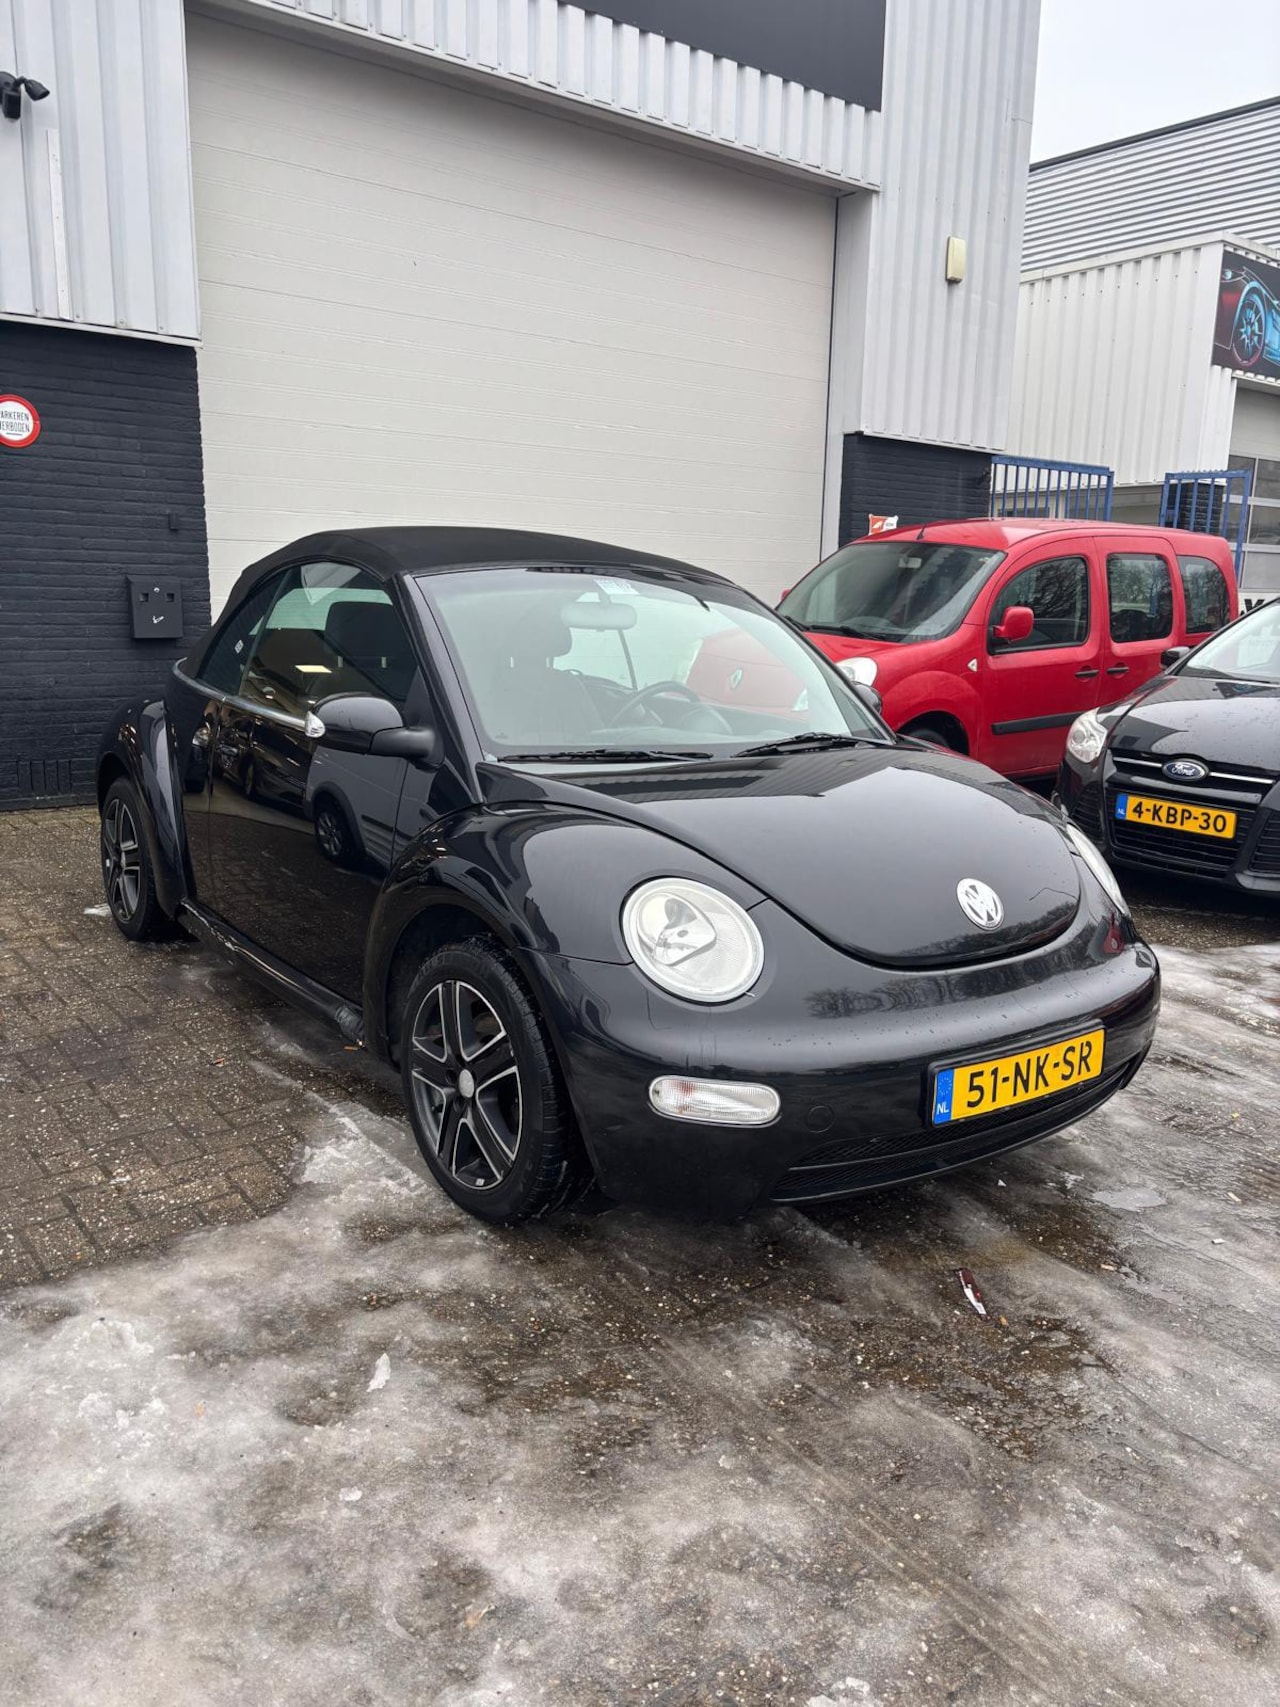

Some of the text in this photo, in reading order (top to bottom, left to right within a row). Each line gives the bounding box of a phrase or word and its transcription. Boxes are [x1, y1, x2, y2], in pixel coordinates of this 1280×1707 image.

[0, 410, 30, 422] ARKEREN
[0, 420, 30, 433] ERBODEN
[1171, 761, 1196, 777] Ford
[1117, 808, 1126, 816] NL
[1132, 801, 1227, 833] 4-KBP-30
[966, 1040, 1093, 1108] 51-NK-SR
[936, 1102, 950, 1115] NL
